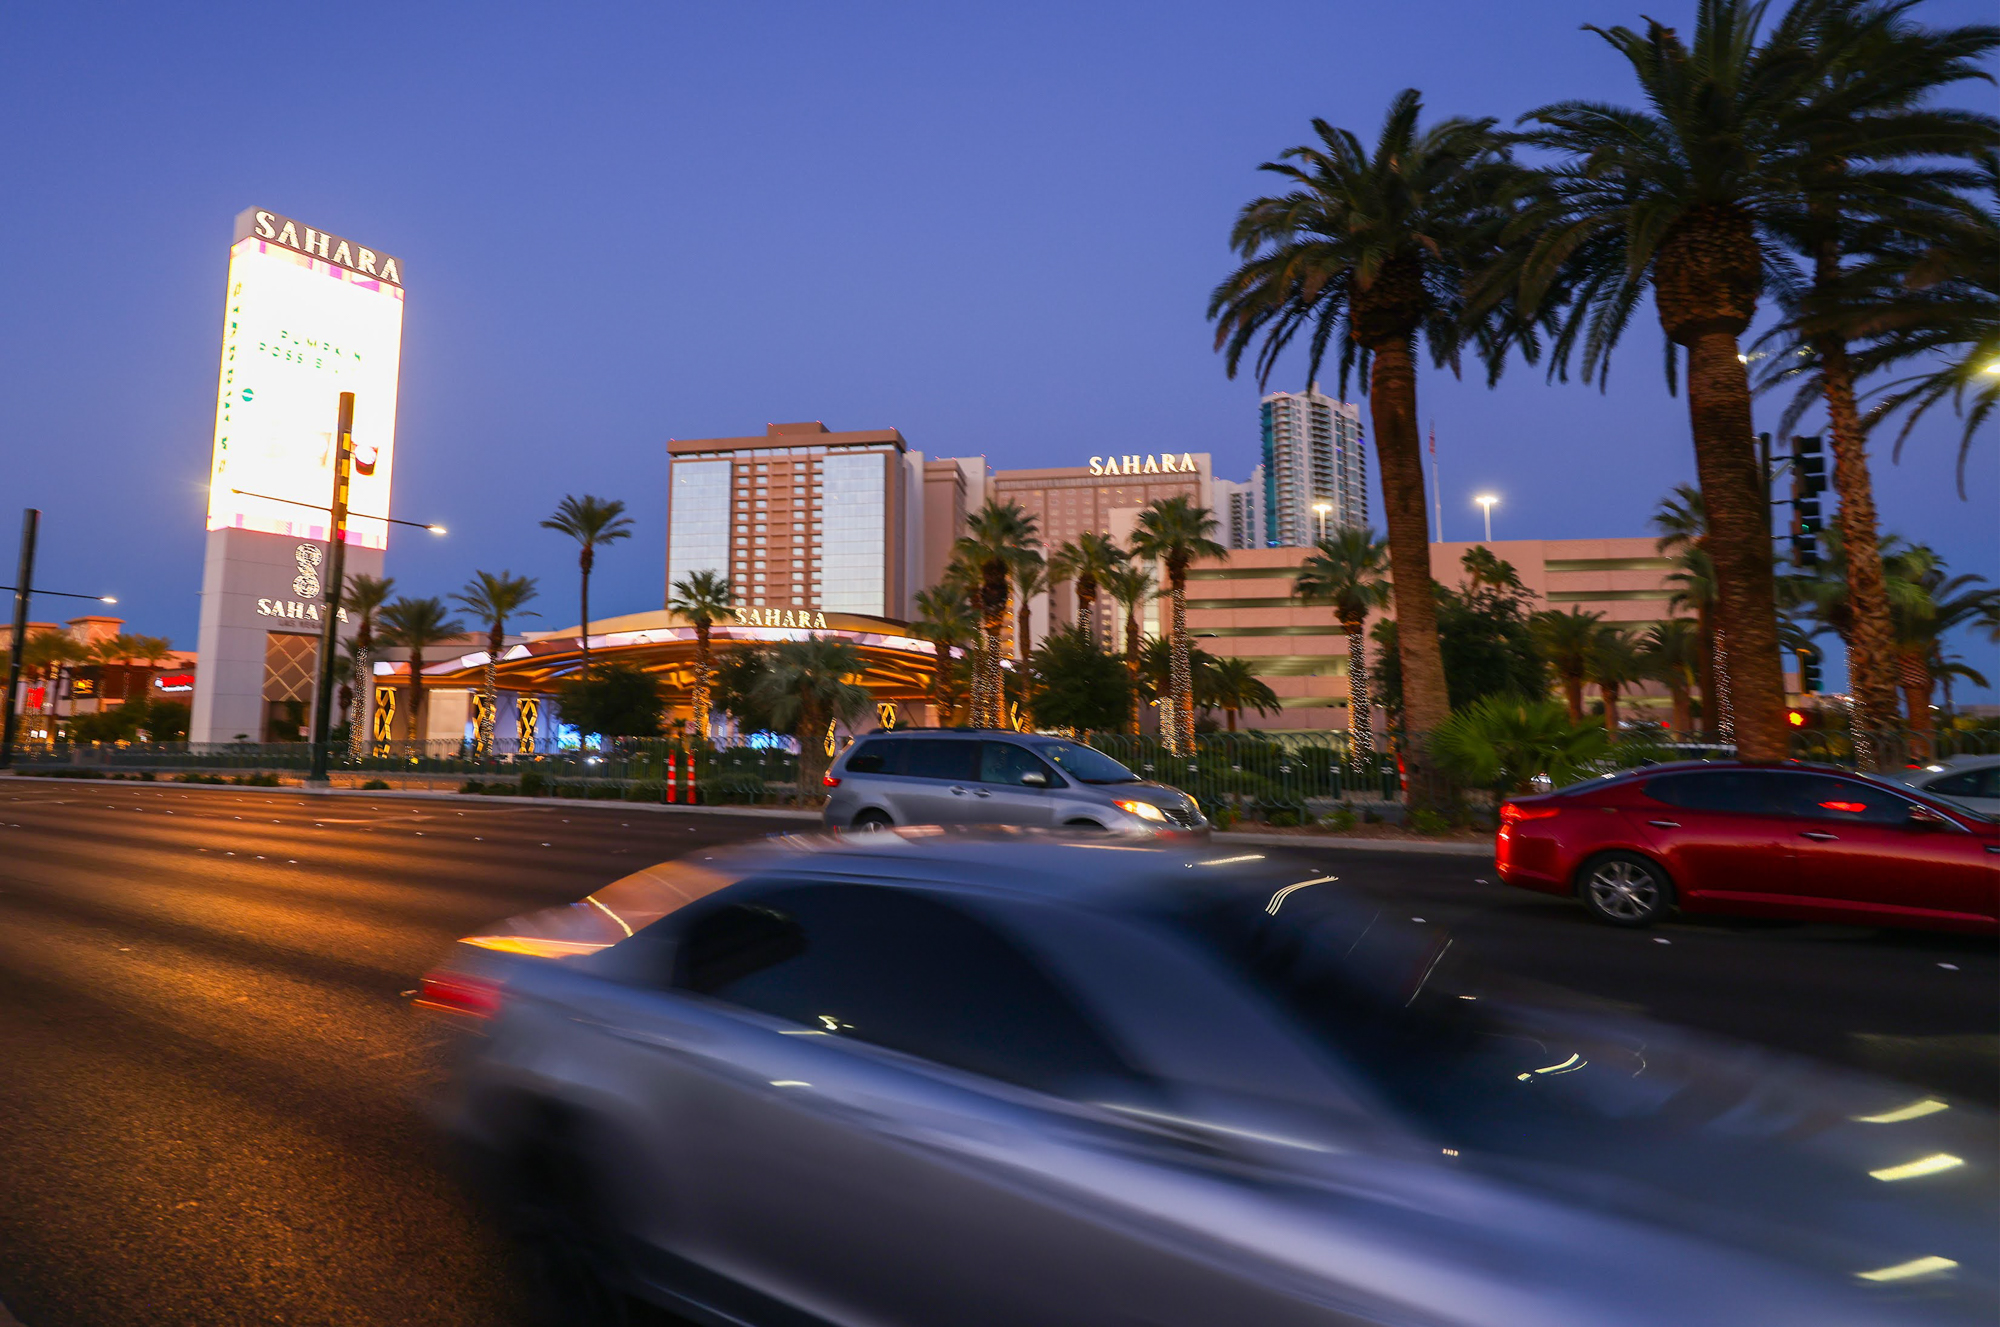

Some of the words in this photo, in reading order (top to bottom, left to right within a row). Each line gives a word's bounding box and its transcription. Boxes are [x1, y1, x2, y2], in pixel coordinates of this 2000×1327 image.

[254, 210, 402, 285] SAHARA
[1088, 452, 1197, 476] SAHARA
[735, 607, 828, 629] SAHARA
